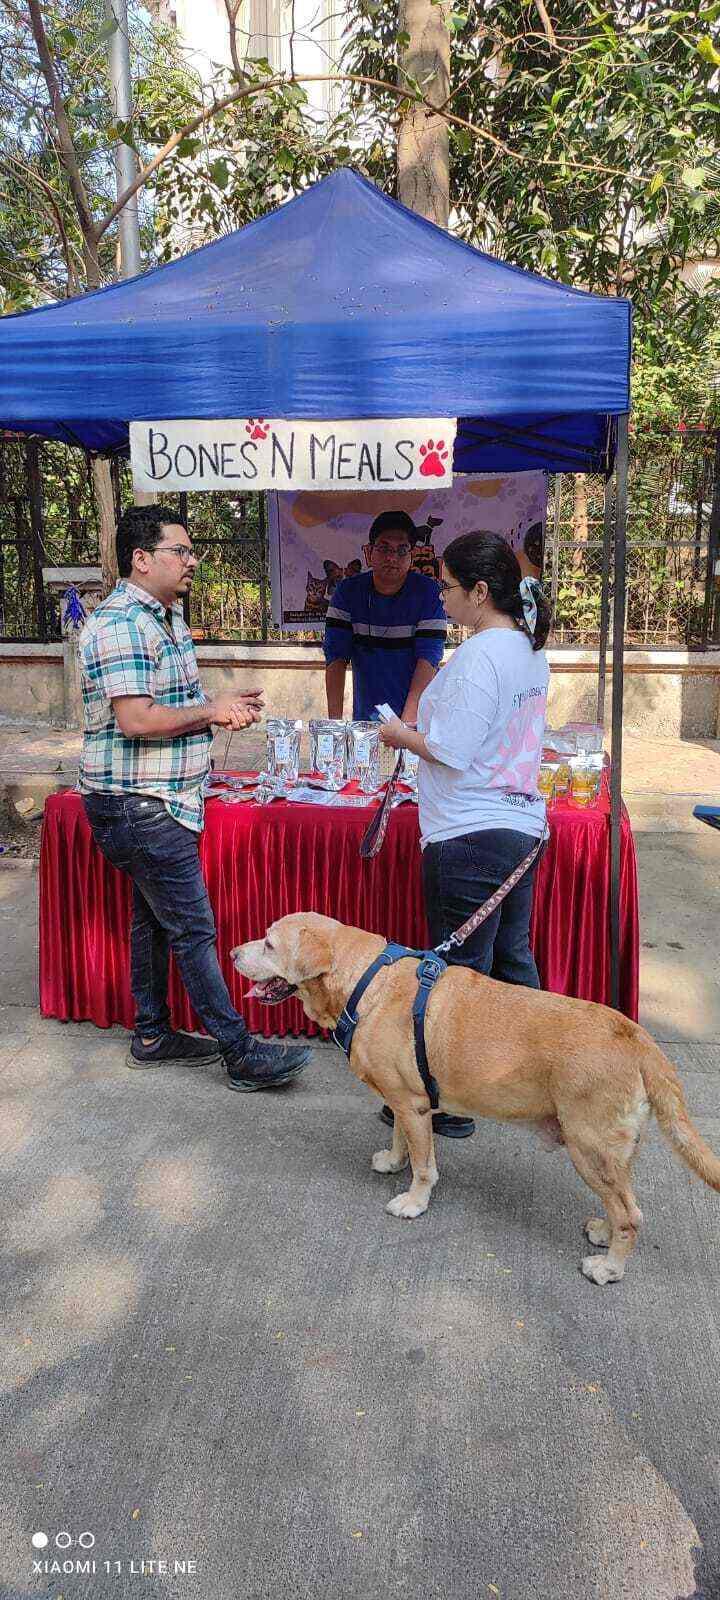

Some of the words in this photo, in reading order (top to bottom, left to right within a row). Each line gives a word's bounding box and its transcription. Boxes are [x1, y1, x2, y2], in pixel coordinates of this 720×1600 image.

[145, 428, 258, 480] BONES
[271, 431, 295, 480] N
[309, 432, 415, 482] MEALS
